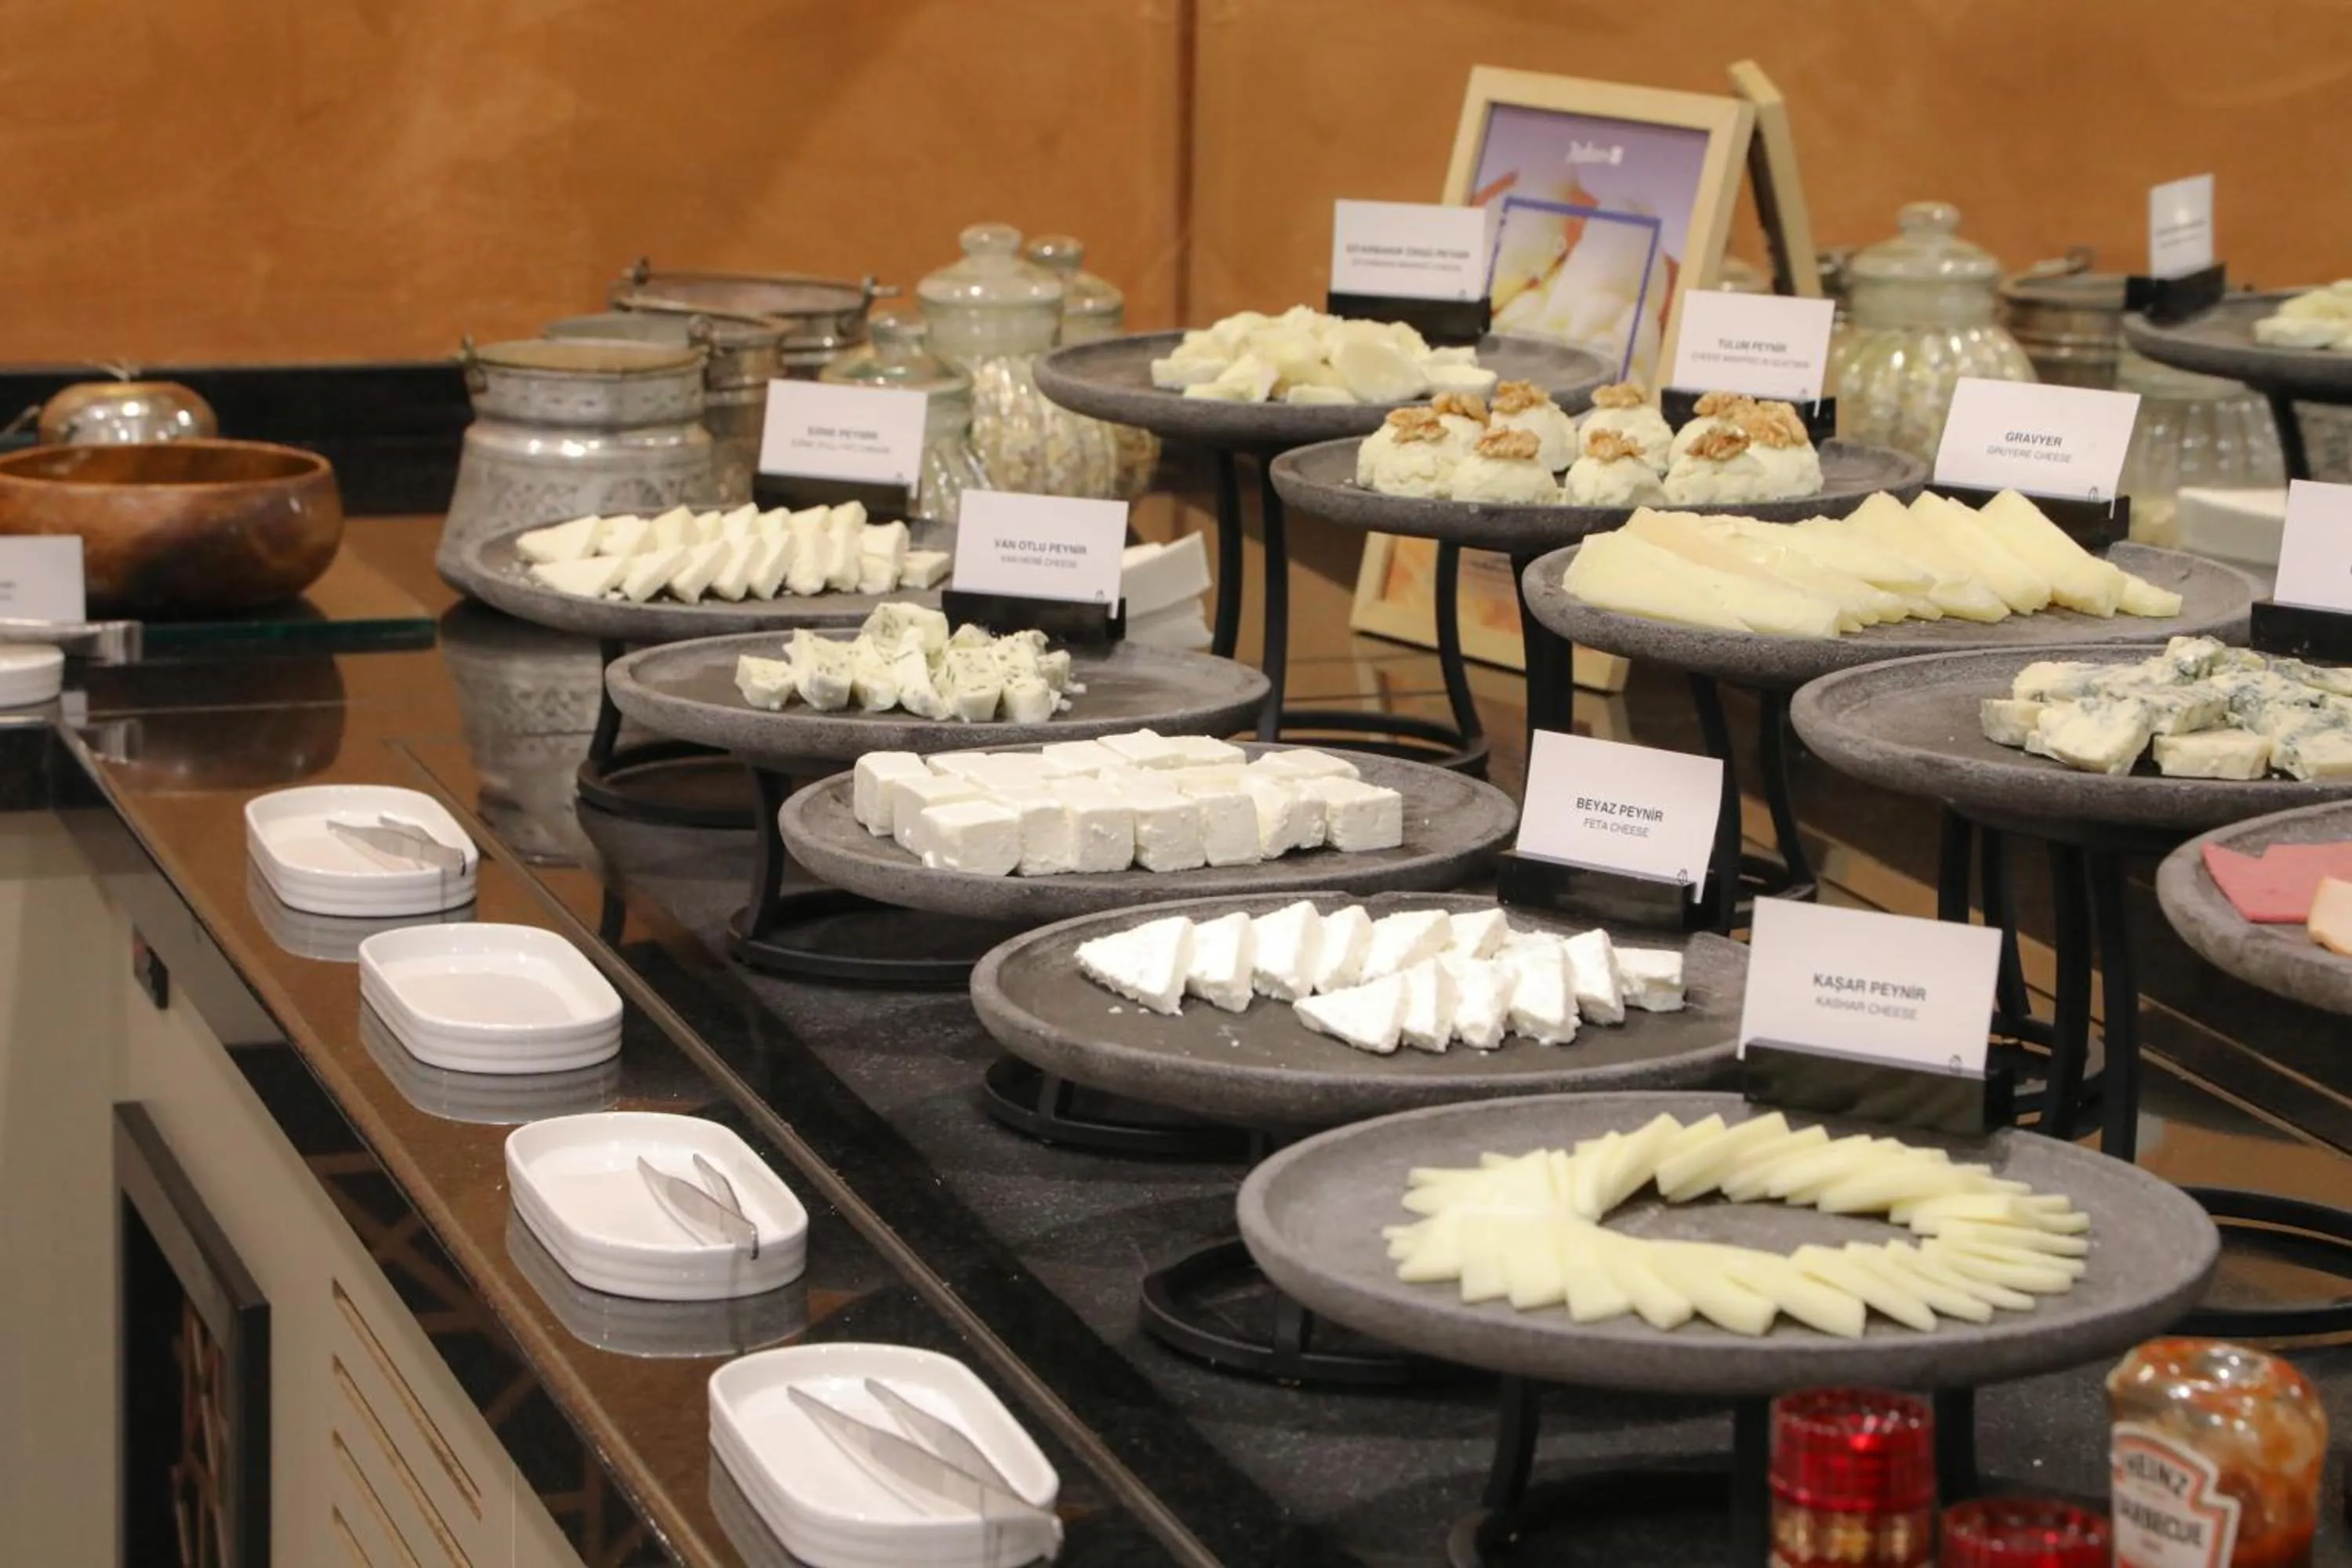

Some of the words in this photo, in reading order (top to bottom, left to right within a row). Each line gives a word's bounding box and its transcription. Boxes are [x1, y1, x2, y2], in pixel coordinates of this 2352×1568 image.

[2005, 431, 2063, 448] GRAVYER
[2034, 449, 2072, 463] CHEESE
[994, 539, 1017, 550] VAN
[1018, 539, 1047, 553] OTLU
[1576, 797, 1617, 815] BEYAZ
[1618, 803, 1664, 822] PEYNİR
[1583, 817, 1608, 831] FETA
[1610, 822, 1650, 839] CHEESE
[1813, 972, 1867, 994] KAŞAR
[1869, 980, 1927, 1002] PEYNİR
[1815, 995, 1865, 1014] KASHAR
[1867, 1003, 1918, 1021] CHEESE
[2127, 1452, 2190, 1497] HEINZ
